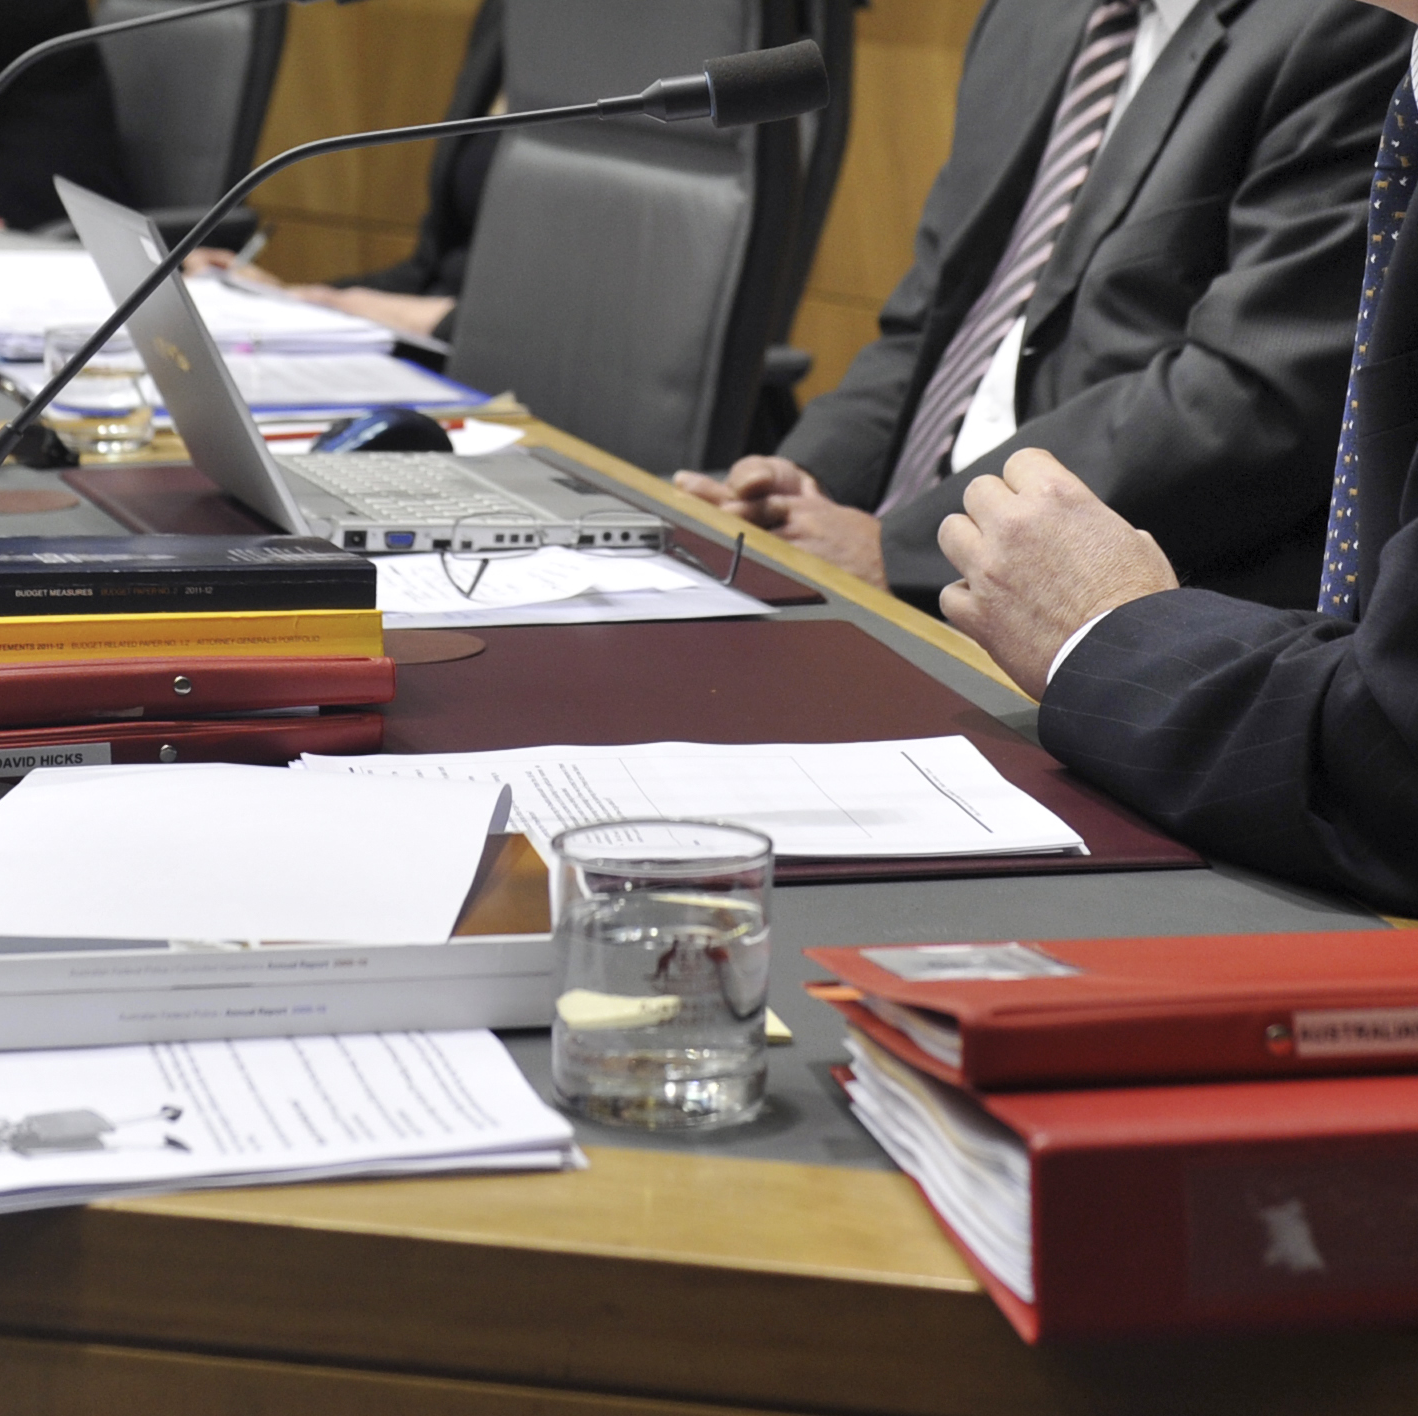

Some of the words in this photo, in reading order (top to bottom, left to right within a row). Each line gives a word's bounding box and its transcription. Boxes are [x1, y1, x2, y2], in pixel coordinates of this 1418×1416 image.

[15, 589, 48, 597] BUDGET
[49, 588, 93, 597] MEASURES
[100, 587, 131, 596] BUDGET
[133, 587, 156, 596] PAPER
[185, 586, 213, 595] 2011-12
[37, 642, 65, 650] 2011-12
[71, 640, 103, 650] BUDGET
[104, 640, 137, 648] RELATED
[139, 639, 163, 648] PAPER
[279, 635, 320, 643] PORTFOLIO
[40, 752, 84, 766] HICKS
